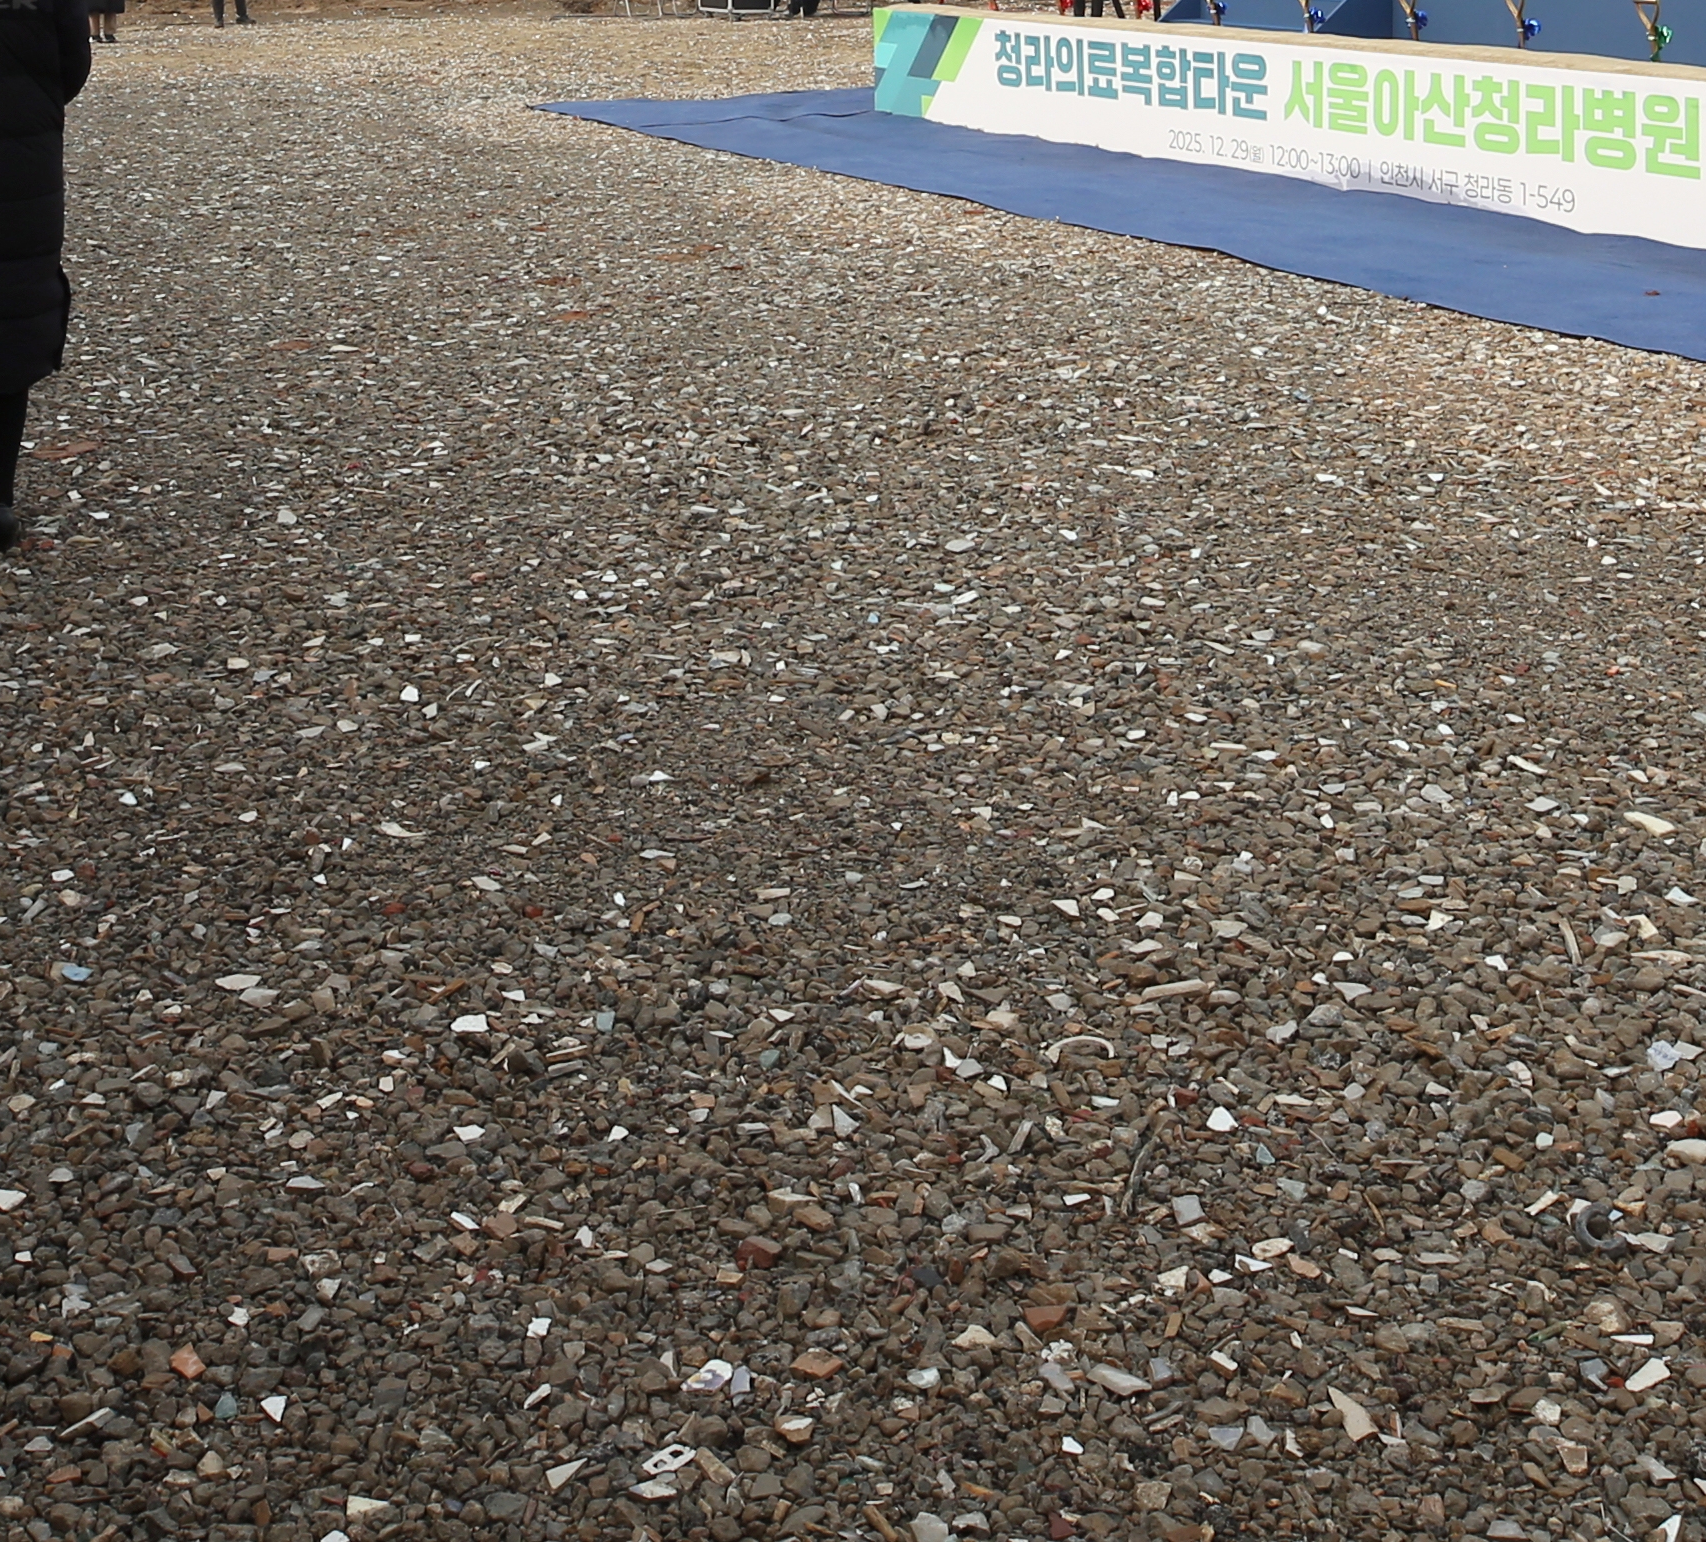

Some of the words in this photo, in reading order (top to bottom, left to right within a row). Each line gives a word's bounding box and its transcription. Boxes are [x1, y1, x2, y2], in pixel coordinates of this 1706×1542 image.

[994, 29, 1268, 122] 청라의료복합타운
[1283, 59, 1702, 181] 서울아산청라병원
[1168, 129, 1205, 154] 2025.
[1209, 135, 1228, 157] 12.
[1269, 144, 1361, 179] 12:00~13:00
[1379, 161, 1424, 191] 인천시
[1428, 169, 1459, 196] 서구
[1464, 172, 1513, 204] 청라동
[1520, 181, 1576, 213] 1-549
